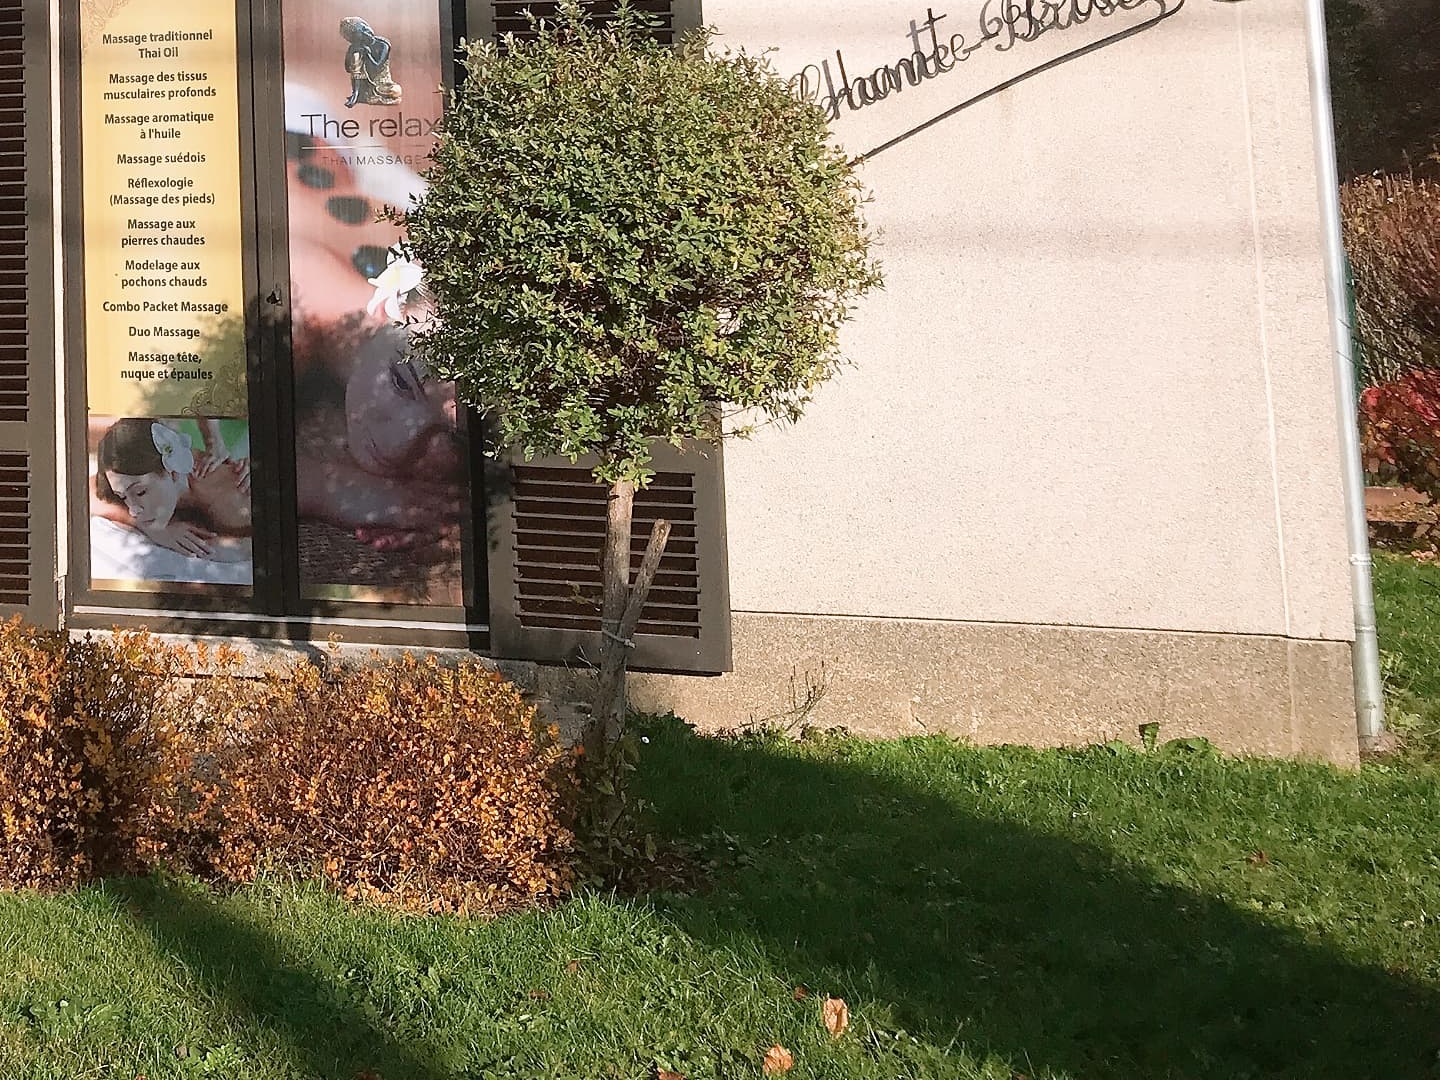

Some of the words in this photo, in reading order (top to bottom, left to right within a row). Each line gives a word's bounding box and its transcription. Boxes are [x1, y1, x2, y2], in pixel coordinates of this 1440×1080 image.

[103, 34, 147, 45] Massage
[150, 29, 213, 42] traditionnel
[139, 48, 161, 59] Thai
[163, 47, 179, 57] Oil
[109, 74, 154, 85] Massage
[157, 72, 175, 82] des
[178, 71, 208, 82] tissus
[103, 88, 166, 100] musculaires
[168, 86, 217, 100] profonds
[105, 114, 150, 125] Massage
[152, 111, 214, 124] aromatique
[300, 114, 359, 138] The
[369, 111, 441, 137] relax
[140, 129, 146, 139] à
[148, 128, 181, 139] l'huile
[117, 154, 162, 166] Massage
[165, 152, 206, 163] suédois
[323, 156, 352, 166] THAI
[356, 155, 423, 165] MASSAGE
[128, 177, 194, 190] Réflexologie
[110, 195, 159, 207] (Massage
[161, 193, 180, 204] des
[182, 193, 215, 206] pieds)
[128, 219, 174, 231] Massage
[176, 220, 196, 229] aux
[121, 235, 158, 248] pierres
[161, 235, 205, 245] chaudes
[125, 259, 178, 272] Modelage
[180, 262, 200, 270] aux
[121, 276, 166, 289] pochons
[169, 276, 208, 287] chauds
[103, 301, 140, 312] Combo
[143, 301, 178, 312] Packet
[181, 301, 228, 314] Massage
[129, 327, 151, 337] Duo
[154, 327, 200, 339] Massage
[129, 352, 175, 364] Massage
[177, 352, 202, 364] tête,
[121, 369, 155, 381] nuque
[157, 369, 168, 379] et
[171, 368, 213, 381] épaules
